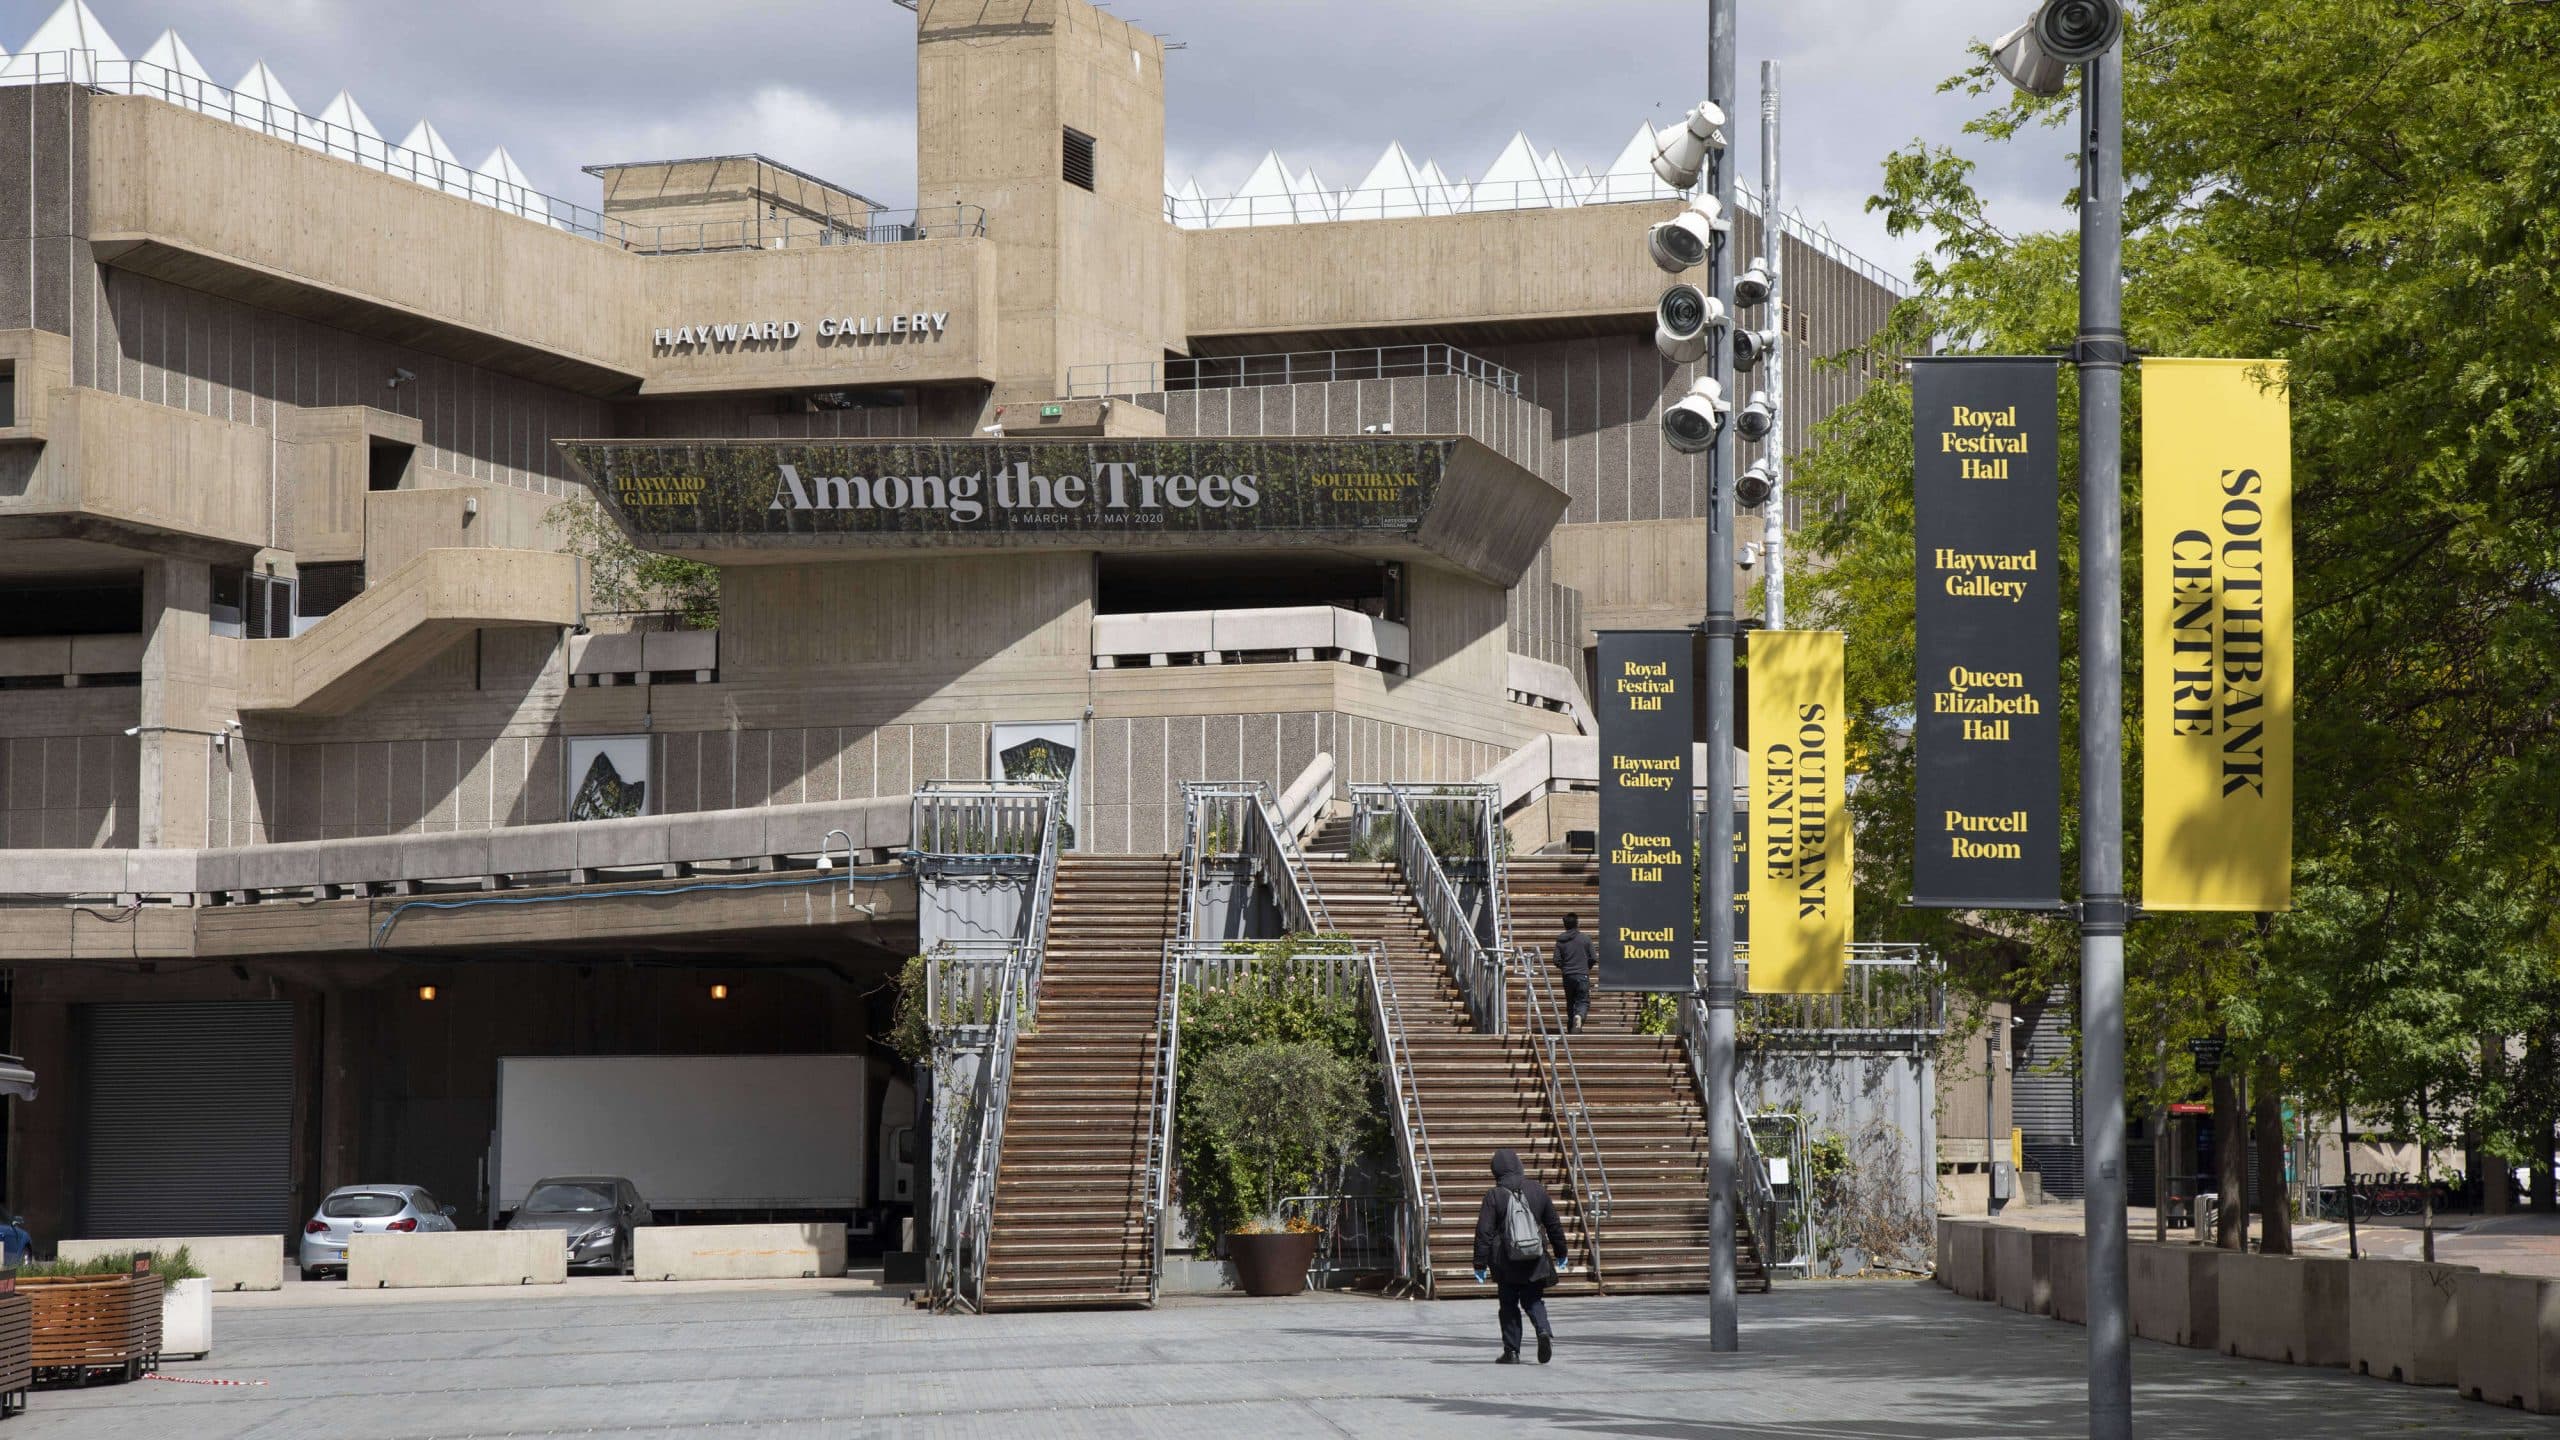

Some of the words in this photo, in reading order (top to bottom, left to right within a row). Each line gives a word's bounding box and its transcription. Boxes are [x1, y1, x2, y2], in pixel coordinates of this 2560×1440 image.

[654, 319, 801, 347] HAYWARD
[817, 311, 949, 338] GALLERY
[1952, 405, 2017, 433] Royal
[1942, 432, 2028, 454] Festival
[1311, 473, 1419, 487] SOUTHBANK
[1961, 458, 2009, 481] Hall
[618, 477, 707, 491] HAYWARD
[769, 464, 982, 523] Among
[992, 461, 1086, 509] the
[1095, 462, 1260, 509] Trees
[1332, 488, 1400, 502] CENTRE
[623, 492, 701, 505] GALLERY
[1011, 514, 1018, 523] 4
[1023, 514, 1068, 523] MARCH
[1086, 514, 1099, 523] 17
[1104, 514, 1130, 523] MAY
[1135, 514, 1164, 523] 2020
[1935, 547, 2037, 575] Hayward
[1945, 576, 2027, 603] Gallery
[2172, 529, 2214, 737] CENTRE
[2221, 468, 2264, 799] SOUTHBANK
[1624, 661, 1667, 679] Royal
[1948, 665, 2024, 691] Queen
[1616, 679, 1675, 693] Festival
[1630, 696, 1662, 711] Hall
[1934, 691, 2040, 715] Elizabeth
[1963, 718, 2010, 741] Hall
[1612, 755, 1681, 773] Hayward
[1619, 773, 1674, 791] Gallery
[1767, 744, 1794, 880] CENTRE
[1799, 703, 1827, 920] SOUTHBANK
[1945, 809, 2028, 833] Purcell
[1621, 832, 1671, 850] Queen
[1951, 836, 2021, 860] Room
[1611, 850, 1682, 865] Elizabeth
[1631, 867, 1663, 882] Hall
[1619, 927, 1675, 942] Purcell
[1623, 944, 1670, 960] Room
